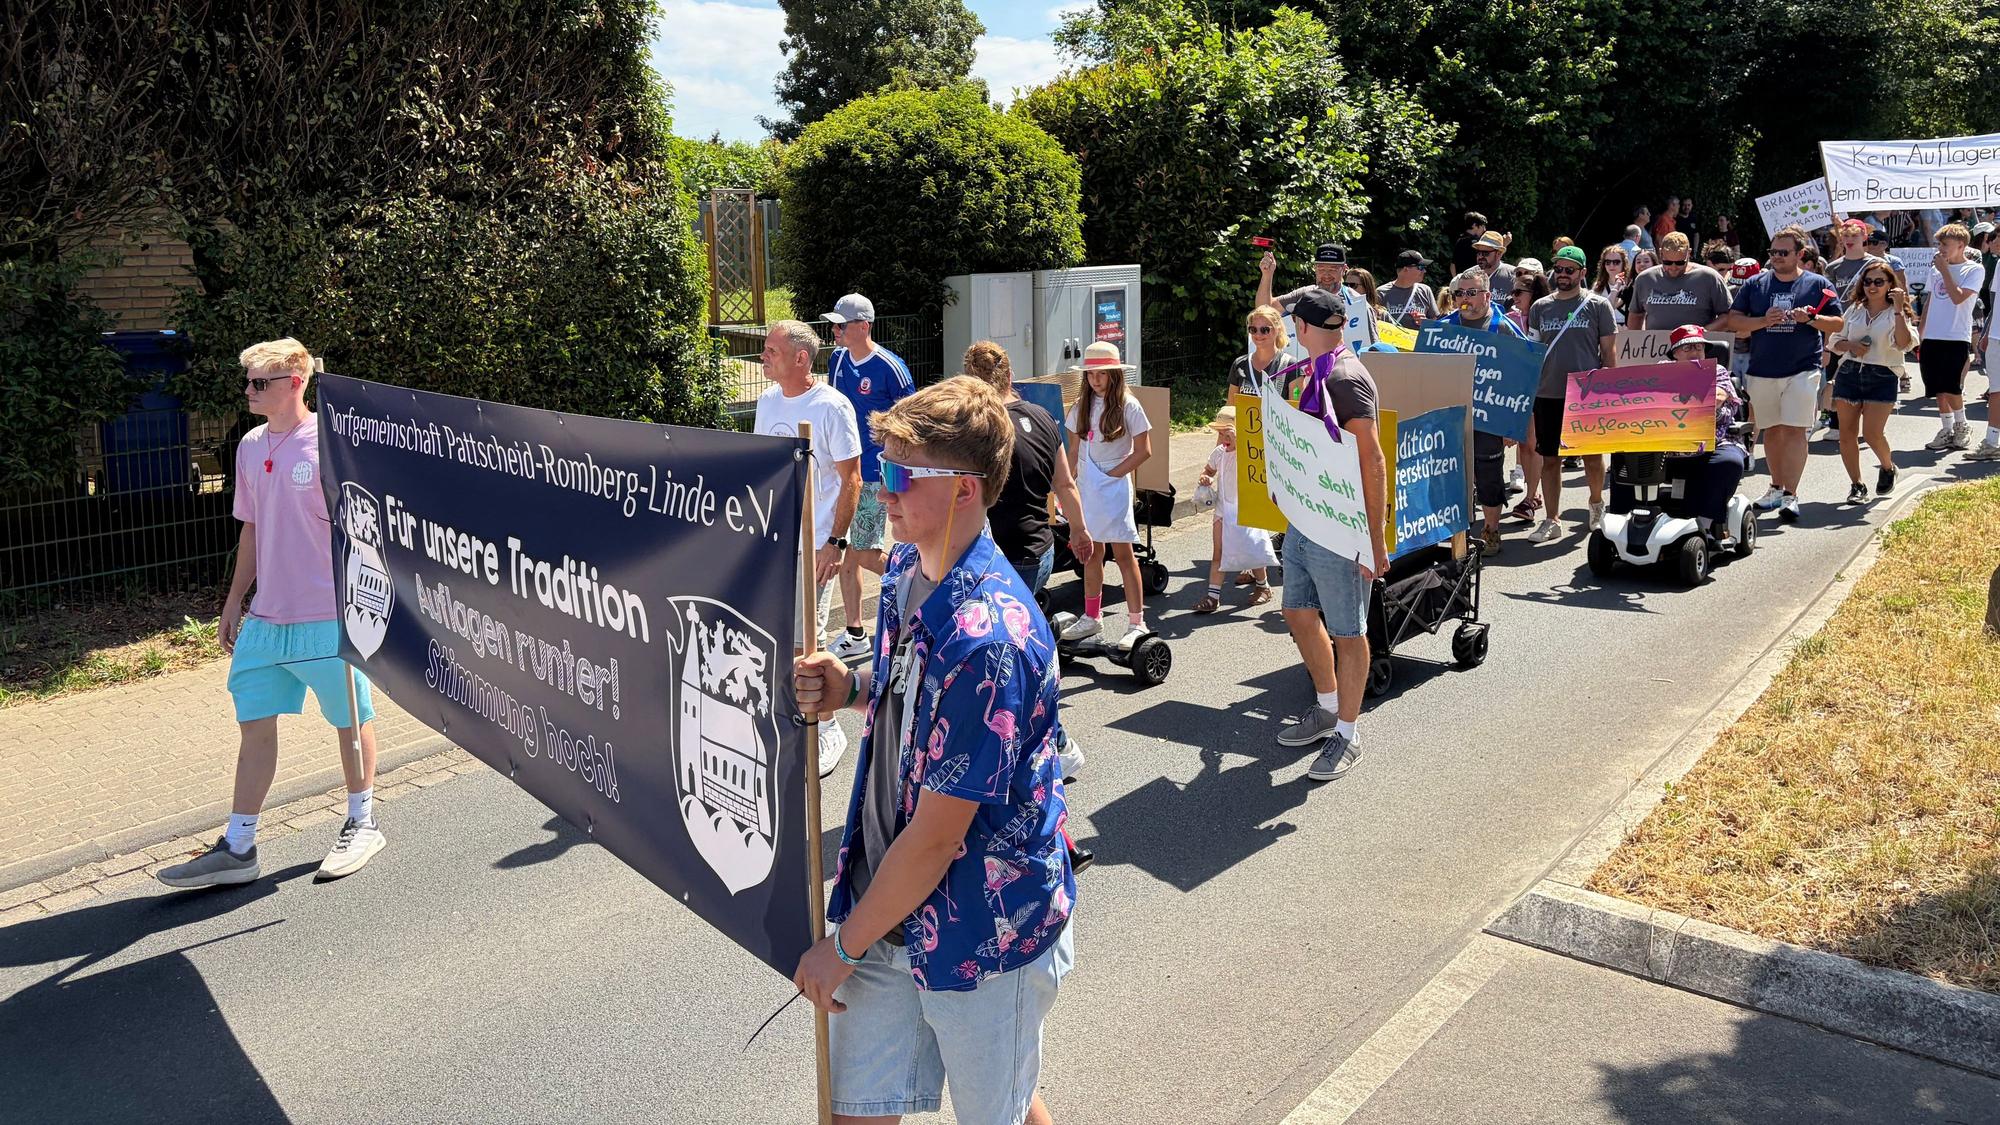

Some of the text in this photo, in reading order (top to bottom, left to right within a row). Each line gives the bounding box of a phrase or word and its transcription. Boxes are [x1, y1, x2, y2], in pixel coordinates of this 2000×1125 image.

[1852, 145, 1897, 168] Kein
[1762, 183, 1826, 212] BRAUCHTU
[1832, 175, 2000, 203] dem Brauchtum fre
[1424, 327, 1498, 359] Tradition
[1620, 334, 1669, 359] Aufla
[1474, 363, 1502, 385] igen
[1473, 385, 1530, 413] ukunft
[1568, 393, 1655, 412] ersticken
[1264, 381, 1318, 458] Tradition
[1396, 427, 1445, 463] dition
[327, 402, 778, 542] Dorfgemeinschaft Pattscheid-Romberg-Linde e.V.
[1318, 470, 1356, 501] statt
[1395, 454, 1459, 486] terstützen
[1396, 504, 1461, 544] sbremsen
[385, 495, 650, 643] Für unsere Tradition
[415, 573, 620, 720] Auflagen runter!
[425, 638, 620, 803] Stimmung hoch!
